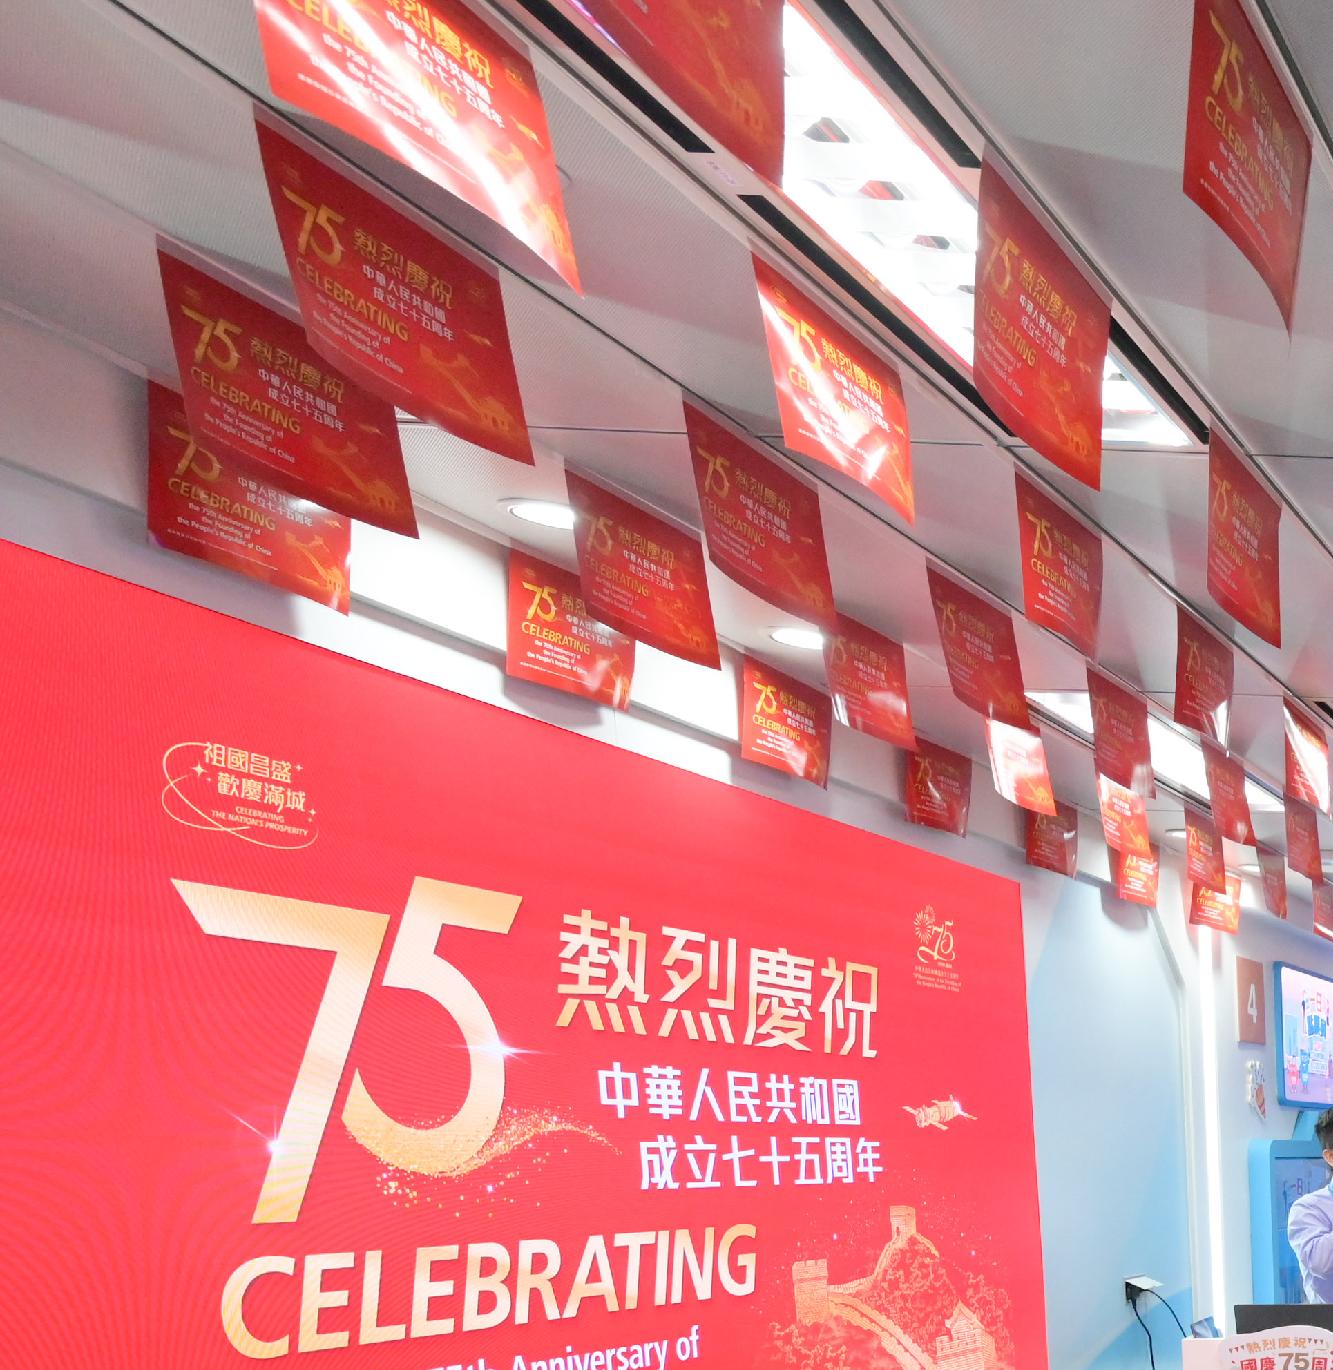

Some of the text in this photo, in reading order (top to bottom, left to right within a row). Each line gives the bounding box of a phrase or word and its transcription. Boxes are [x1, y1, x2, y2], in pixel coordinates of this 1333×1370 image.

[1209, 10, 1244, 114] 75
[1204, 95, 1275, 211] CELEBRATING
[281, 185, 346, 267] 75
[352, 227, 454, 310] 熱烈慶祝
[984, 224, 1021, 298] 75
[296, 255, 411, 343] CELEBRATING
[362, 264, 447, 325] 中華人民共和國
[373, 286, 455, 342] 成立七十五周年
[181, 304, 243, 374] 75
[250, 335, 345, 403] 熱烈慶祝
[258, 367, 338, 417] 中華人民共和國
[190, 365, 302, 435] CELEBRATING
[268, 387, 346, 433] 成立七十五周年
[167, 477, 278, 532] CELEBRATING
[521, 581, 558, 622] 75
[520, 621, 591, 656] CELEBRATING
[203, 741, 292, 783] 祖國昌盛
[217, 772, 306, 813] 歡慶滿城
[235, 806, 285, 823] CELEBRATING
[265, 821, 309, 836] PROSPERITY
[556, 908, 879, 1059] 熱烈慶祝
[1247, 984, 1258, 1025] 4
[170, 876, 522, 1224] 75
[598, 1062, 861, 1126] 中華人民共和國
[640, 1136, 883, 1190] 成立七十五周年
[221, 1223, 757, 1359] CELEBRATING
[676, 1324, 700, 1359] of
[1247, 1337, 1307, 1352] 熱烈慶祝
